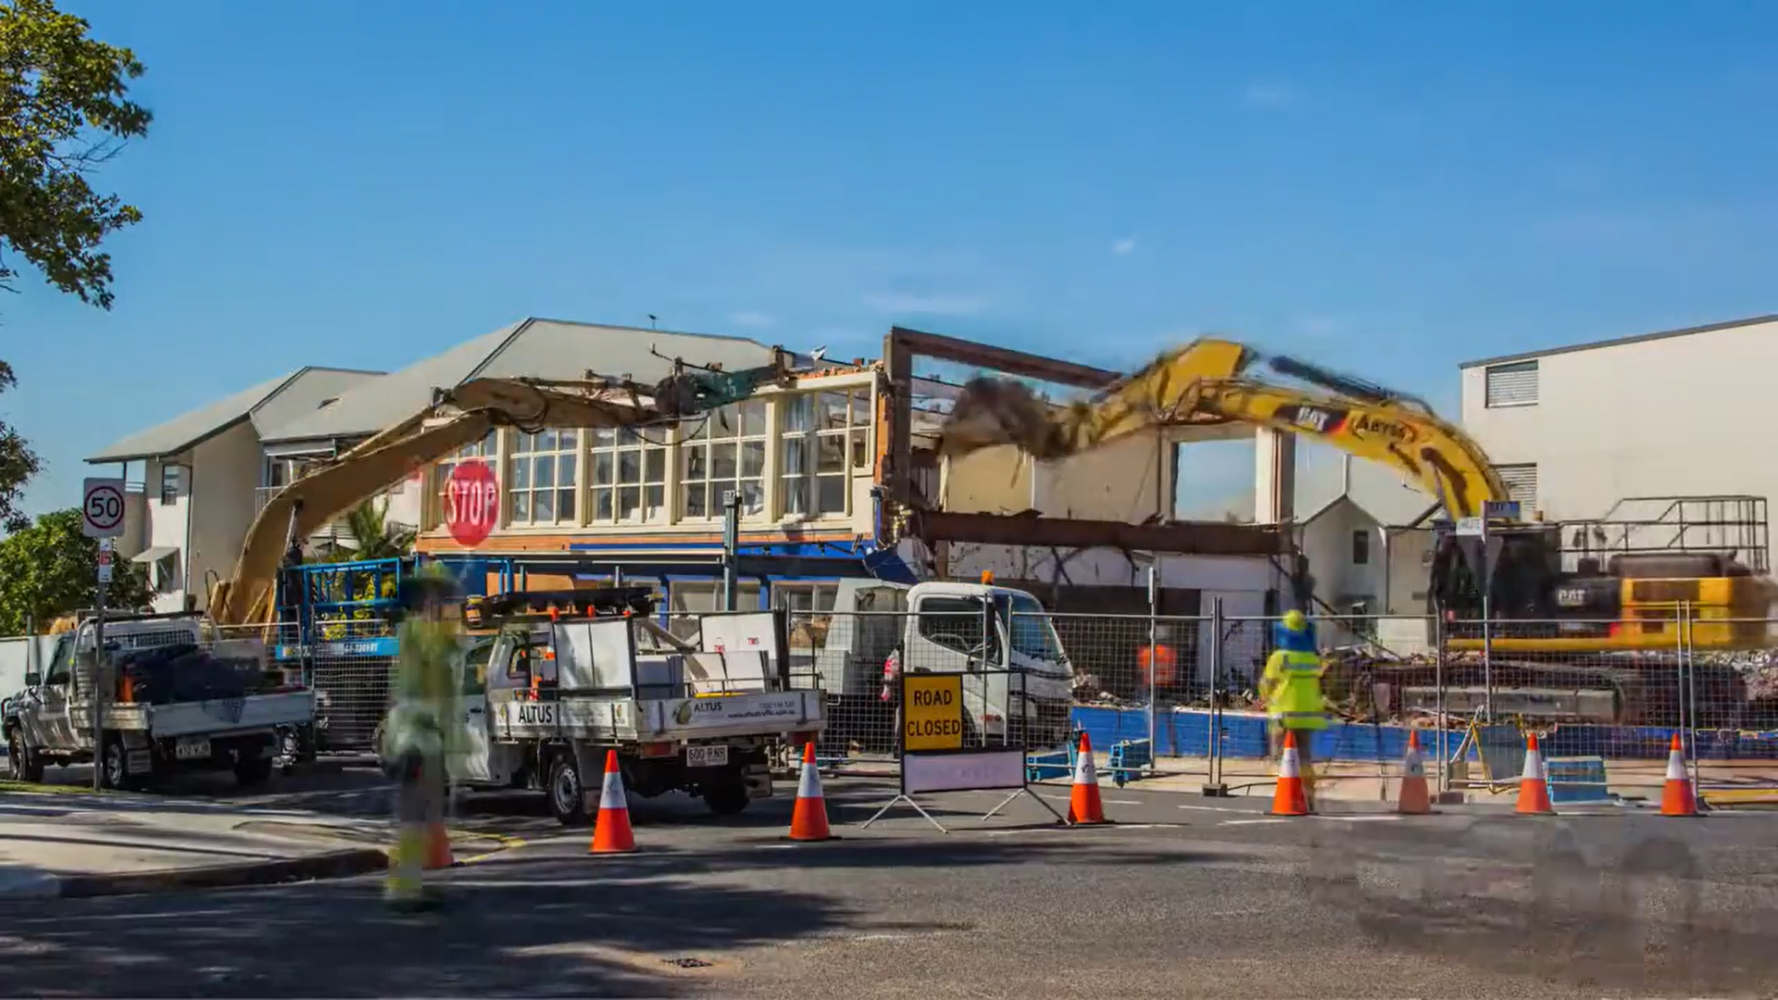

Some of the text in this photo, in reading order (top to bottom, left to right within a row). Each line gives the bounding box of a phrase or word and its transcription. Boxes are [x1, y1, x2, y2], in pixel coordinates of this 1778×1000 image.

[91, 497, 120, 518] 50
[446, 480, 496, 527] STOP
[694, 701, 722, 712] ALTUS
[913, 690, 952, 706] ROAD
[518, 704, 552, 723] ALTUS
[907, 719, 961, 736] CLOSED
